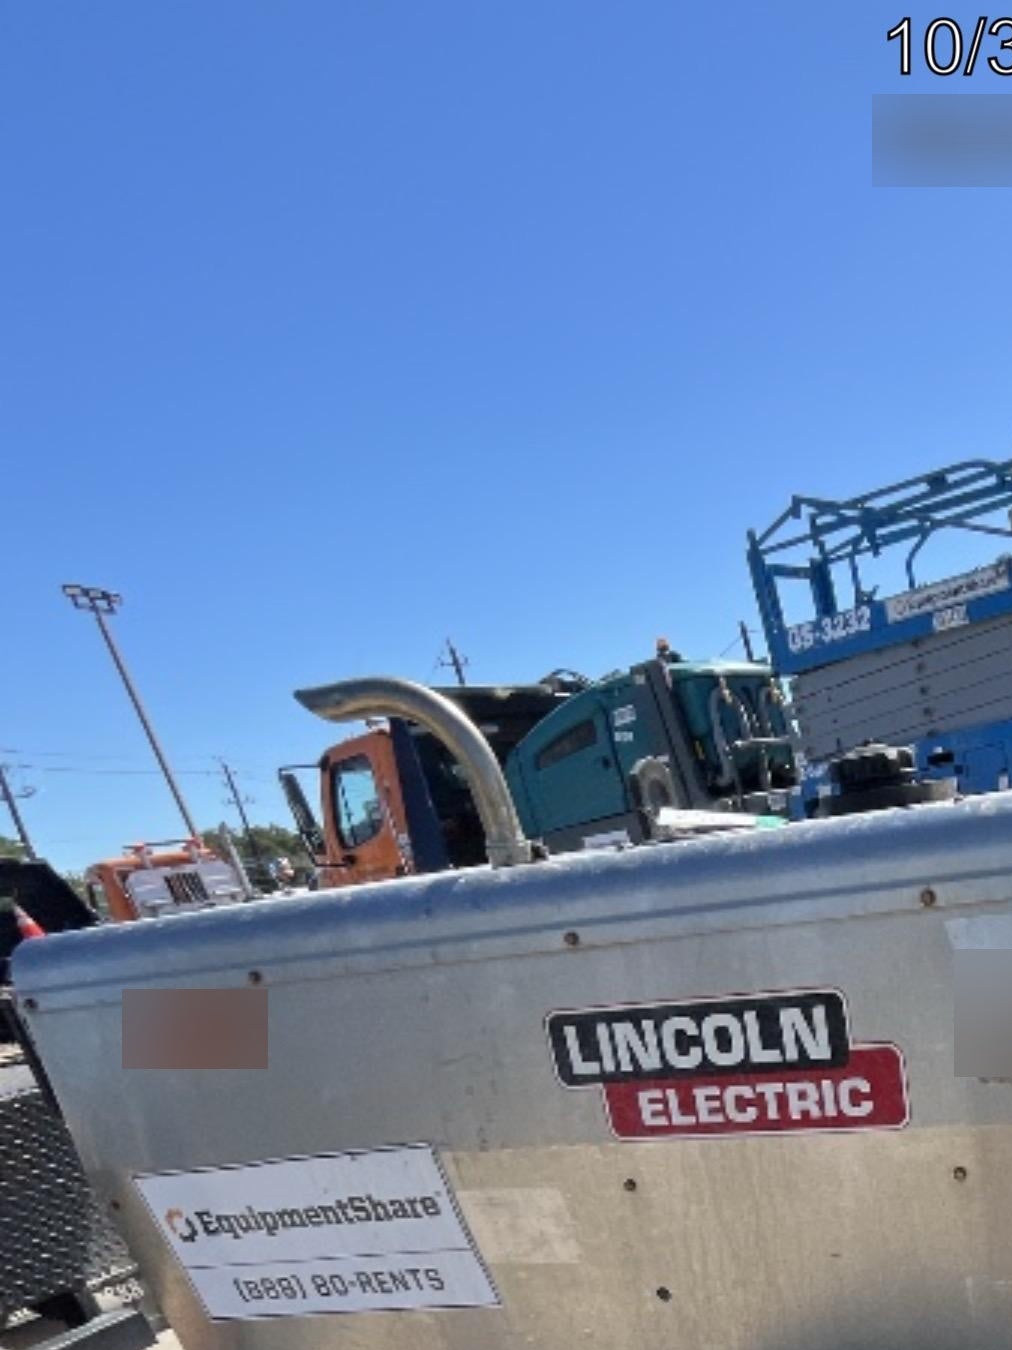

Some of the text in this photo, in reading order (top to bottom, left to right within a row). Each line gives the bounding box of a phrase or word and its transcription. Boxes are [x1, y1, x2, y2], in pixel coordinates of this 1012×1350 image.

[563, 1004, 832, 1076] LINCOLN
[637, 1076, 874, 1128] ELECTRIC
[195, 1194, 441, 1240] EquipmentShare
[233, 1267, 445, 1304] (888) 80-RENTS
